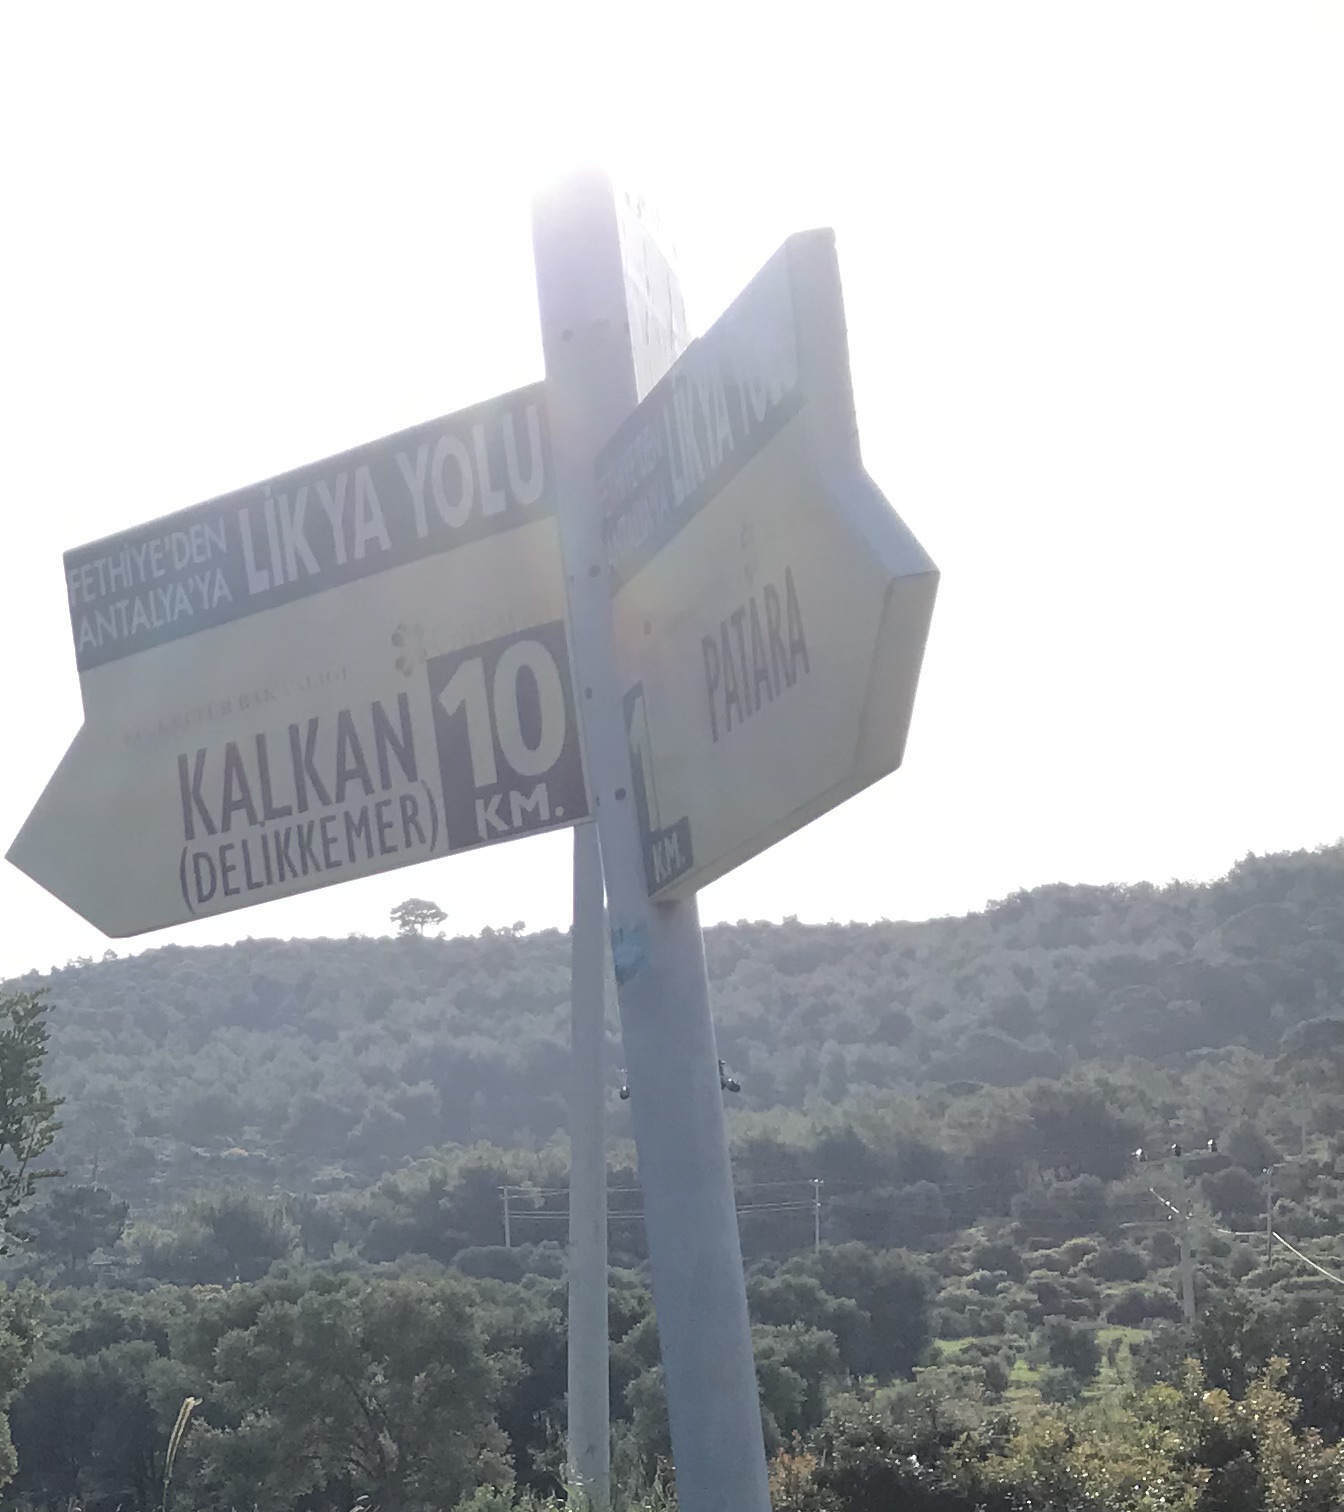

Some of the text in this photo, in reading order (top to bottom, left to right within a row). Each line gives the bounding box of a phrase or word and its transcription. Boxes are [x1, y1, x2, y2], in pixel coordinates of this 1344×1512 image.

[238, 465, 392, 595] LİKYA
[395, 403, 546, 540] YOLU
[76, 570, 234, 653] ANTALYA'YA
[701, 565, 810, 743] PATARA
[177, 692, 419, 841] KALKAN
[437, 639, 567, 789] 10
[628, 697, 660, 833] 1
[474, 782, 565, 837] KM.
